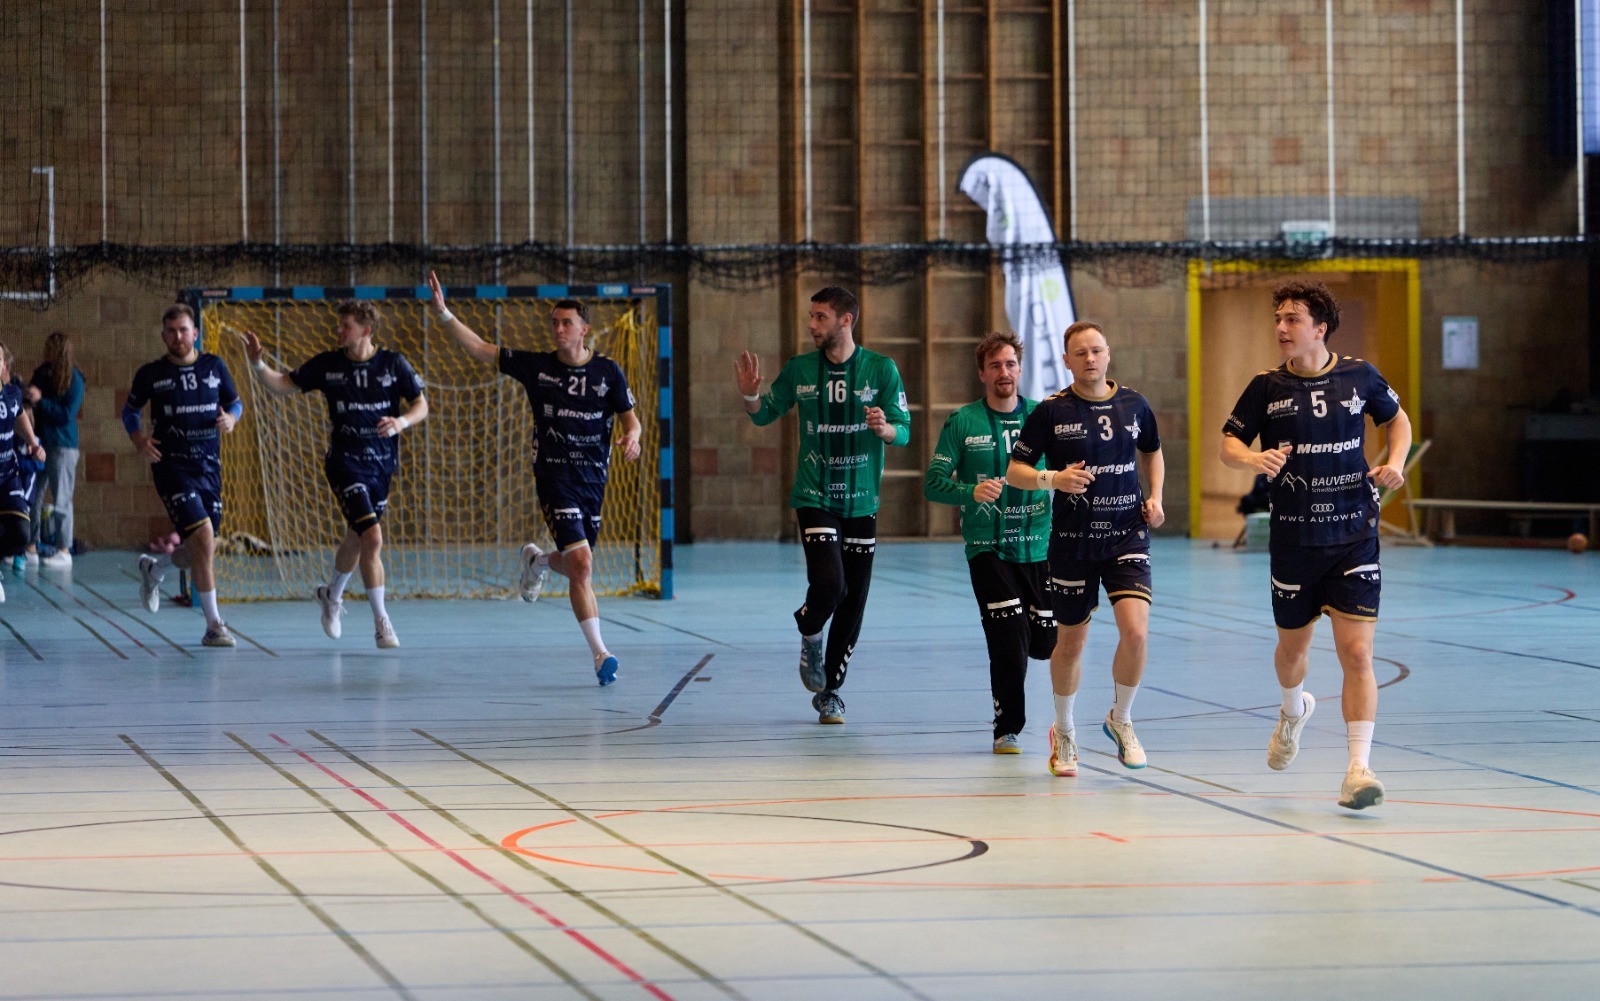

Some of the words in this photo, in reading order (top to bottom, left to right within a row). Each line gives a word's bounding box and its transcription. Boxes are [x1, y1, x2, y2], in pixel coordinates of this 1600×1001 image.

[180, 373, 198, 391] 13
[353, 369, 368, 388] 11
[567, 375, 587, 397] 21
[825, 379, 848, 403] 16
[1310, 390, 1328, 418] 5
[1097, 415, 1114, 441] 3
[1296, 436, 1361, 455] Mangold
[1311, 470, 1363, 487] BAUVEREIN
[1279, 514, 1305, 522] WWG
[1309, 510, 1363, 523] AUTOWELT
